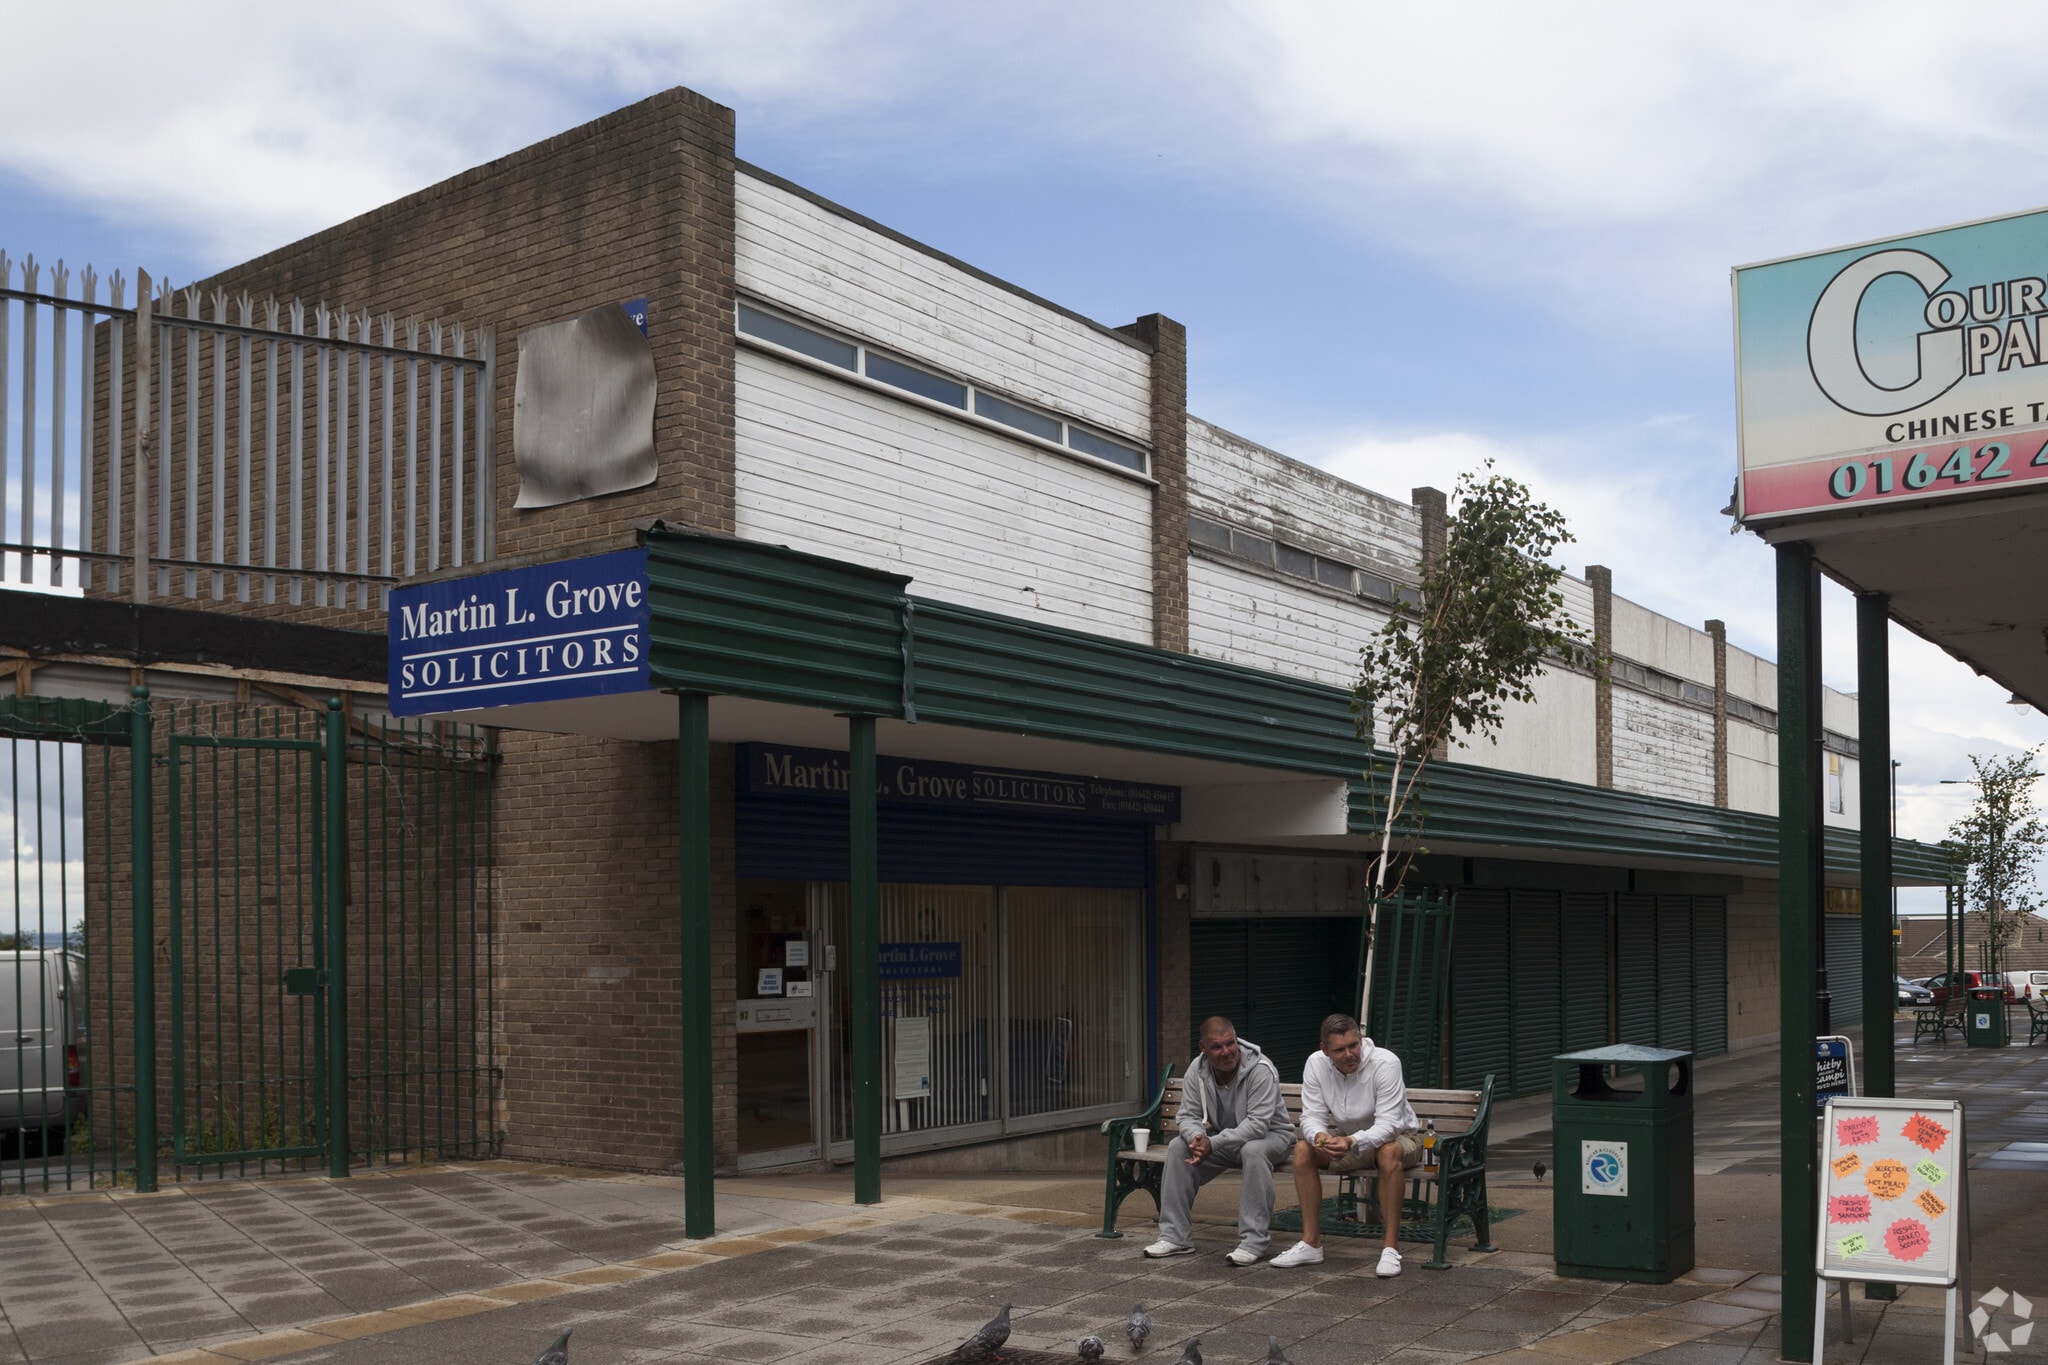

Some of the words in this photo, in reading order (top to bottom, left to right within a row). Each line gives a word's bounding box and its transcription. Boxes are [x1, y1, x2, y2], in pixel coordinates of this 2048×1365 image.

[1807, 248, 2048, 417] GOUR
[1885, 405, 2014, 443] CHINESE
[2026, 401, 2048, 423] T
[1829, 441, 2012, 500] 01642
[401, 594, 496, 641] Martin
[505, 588, 536, 626] L.
[545, 579, 642, 619] Grove
[402, 634, 639, 689] SOLICITORS
[897, 765, 967, 799] Grove
[972, 777, 1086, 805] SOLICITORS
[1102, 800, 1117, 809] Fax:
[919, 947, 957, 962] Grove
[1875, 1165, 1908, 1173] SELECTION
[1883, 1180, 1906, 1188] MEALS
[1892, 1223, 1917, 1235] FRESHLY
[1897, 1230, 1921, 1243] BAKED
[1899, 1238, 1926, 1250] SCONES
